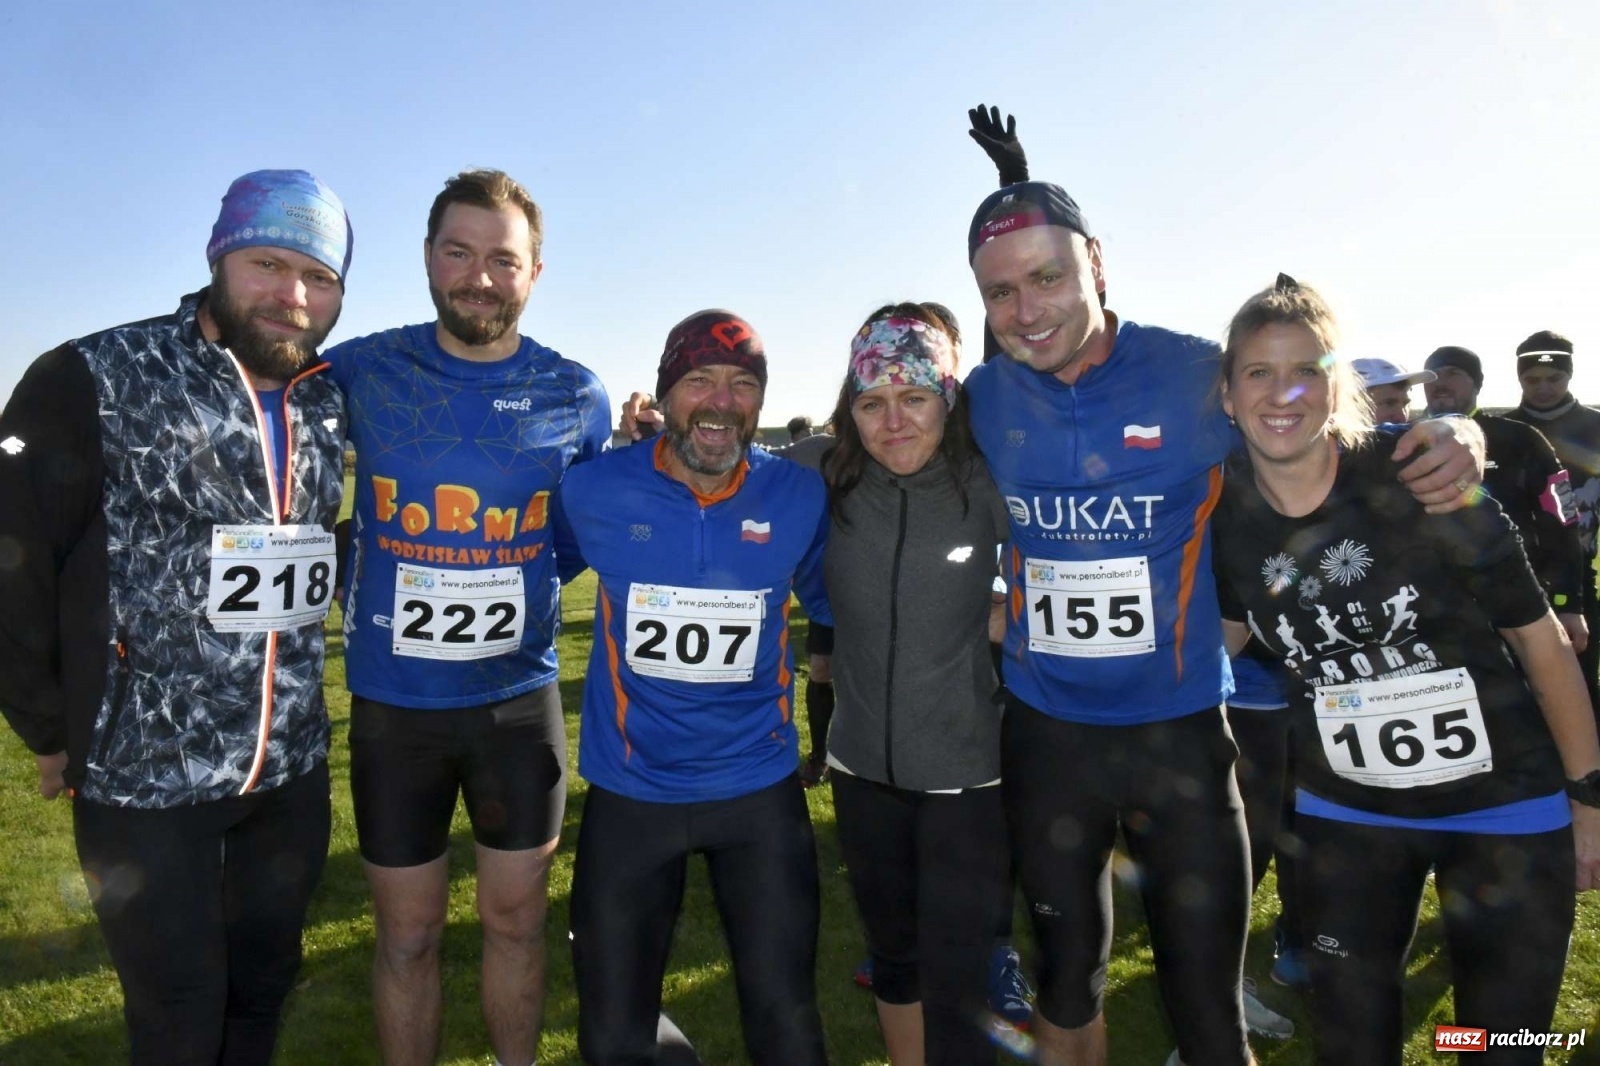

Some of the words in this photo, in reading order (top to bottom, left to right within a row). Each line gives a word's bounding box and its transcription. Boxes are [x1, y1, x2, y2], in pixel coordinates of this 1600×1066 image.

[493, 398, 532, 411] quest
[1005, 495, 1164, 530] DUKAT
[271, 536, 332, 547] www.personalbest.pl
[441, 577, 519, 590] www.personalbest.pl
[1060, 568, 1143, 581] www.personalbest.pl
[217, 561, 330, 612] 218
[676, 598, 756, 610] www.personalbest.pl
[1347, 601, 1366, 614] 01.
[401, 600, 516, 643] 222
[1035, 594, 1144, 640] 155
[1352, 615, 1372, 627] 01.
[634, 619, 752, 665] 207
[1367, 680, 1464, 703] www.personalbest.pl
[1332, 708, 1477, 768] 165
